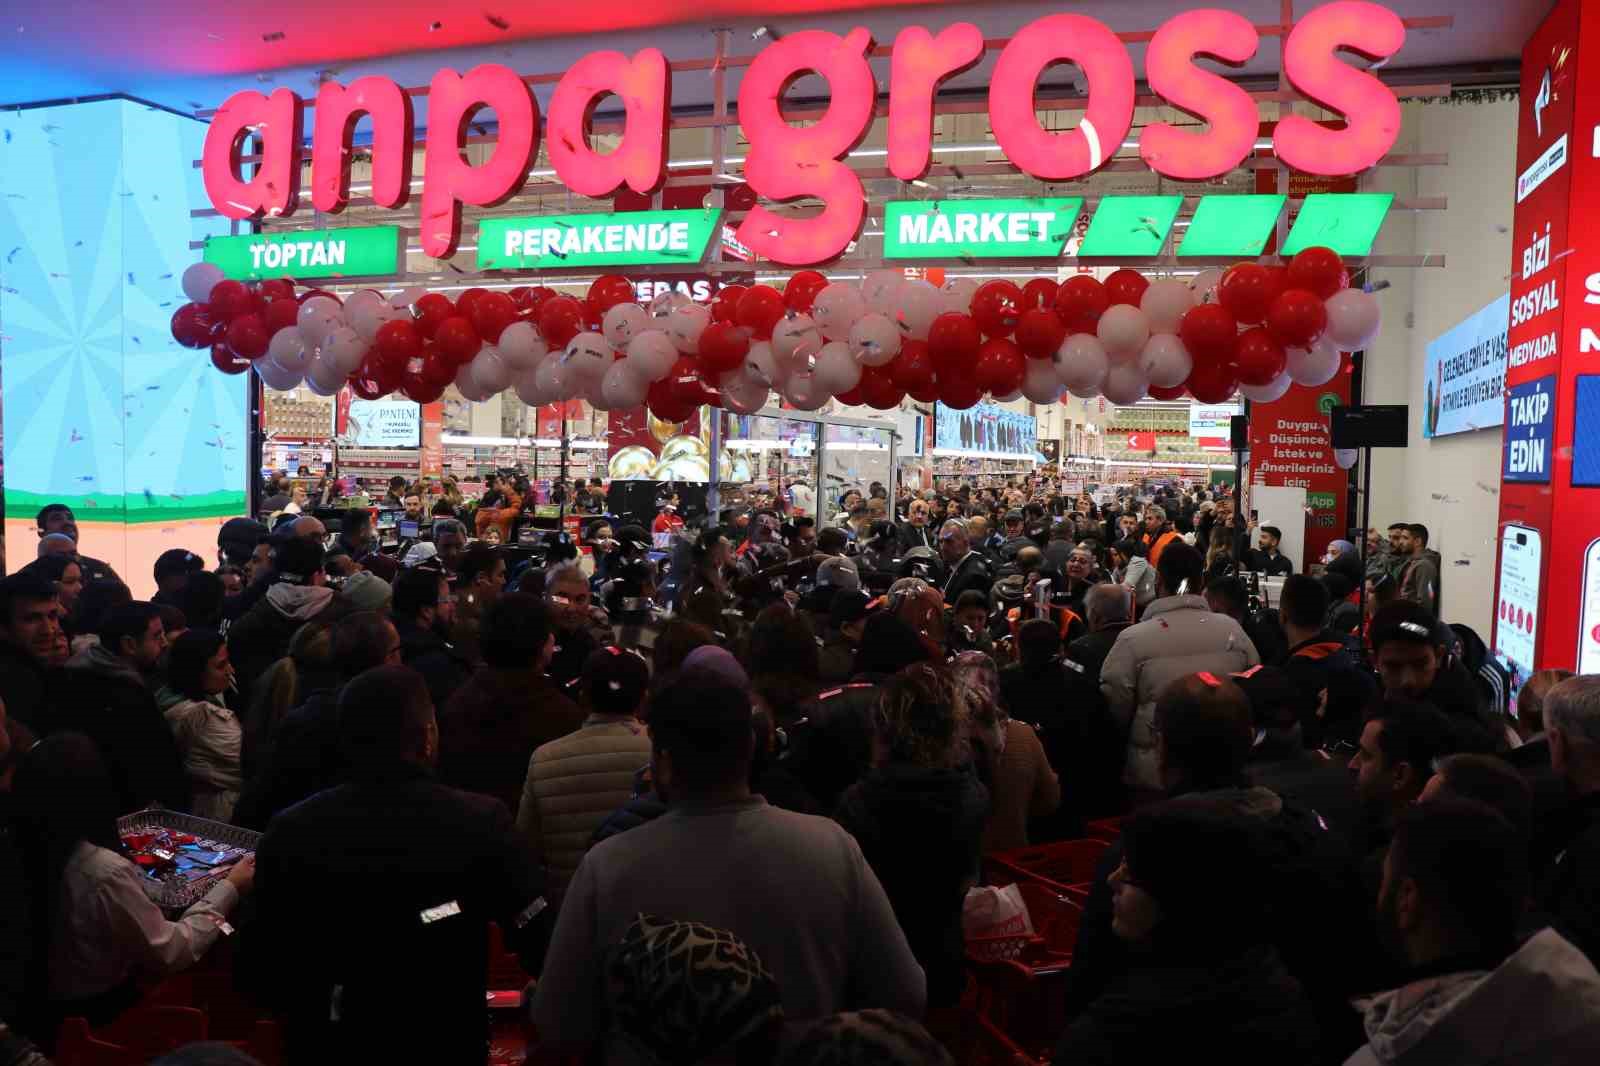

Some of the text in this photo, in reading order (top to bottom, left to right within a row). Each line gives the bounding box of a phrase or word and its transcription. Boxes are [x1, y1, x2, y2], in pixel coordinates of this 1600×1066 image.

[250, 240, 346, 269] TOPTAN
[504, 222, 690, 257] PERAKENDE
[898, 211, 1057, 244] MARKET
[1522, 221, 1551, 280] BİZİ
[1511, 280, 1559, 327] SOSYAL
[1508, 331, 1557, 368] MEDYADA
[1511, 383, 1549, 427] TAKİP
[1269, 434, 1329, 446] Düşünce,
[1273, 446, 1306, 458] İstek
[1509, 427, 1545, 473] EDİN
[1260, 460, 1335, 473] Önerileriniz
